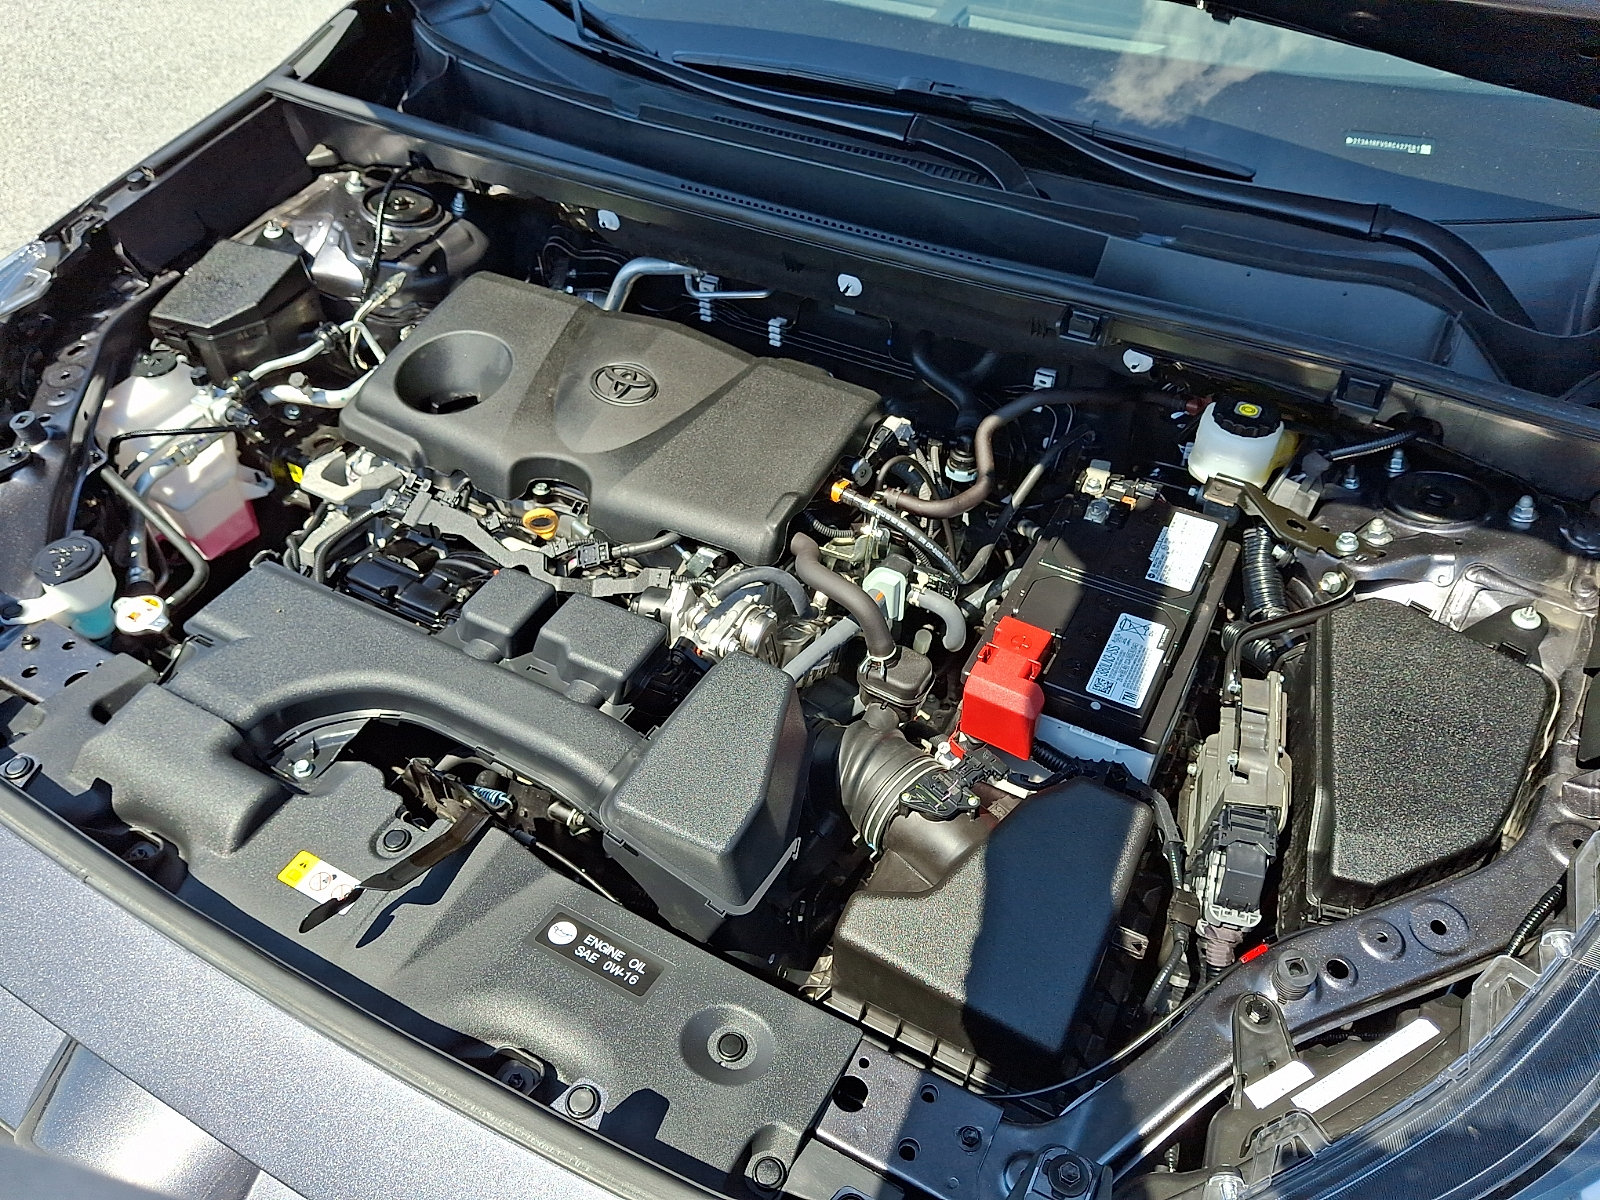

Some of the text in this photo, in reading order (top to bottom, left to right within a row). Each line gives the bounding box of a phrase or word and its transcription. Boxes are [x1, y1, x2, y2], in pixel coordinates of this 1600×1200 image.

[574, 945, 640, 985] SAE 0W-16
[583, 934, 647, 975] ENGINE OIL
